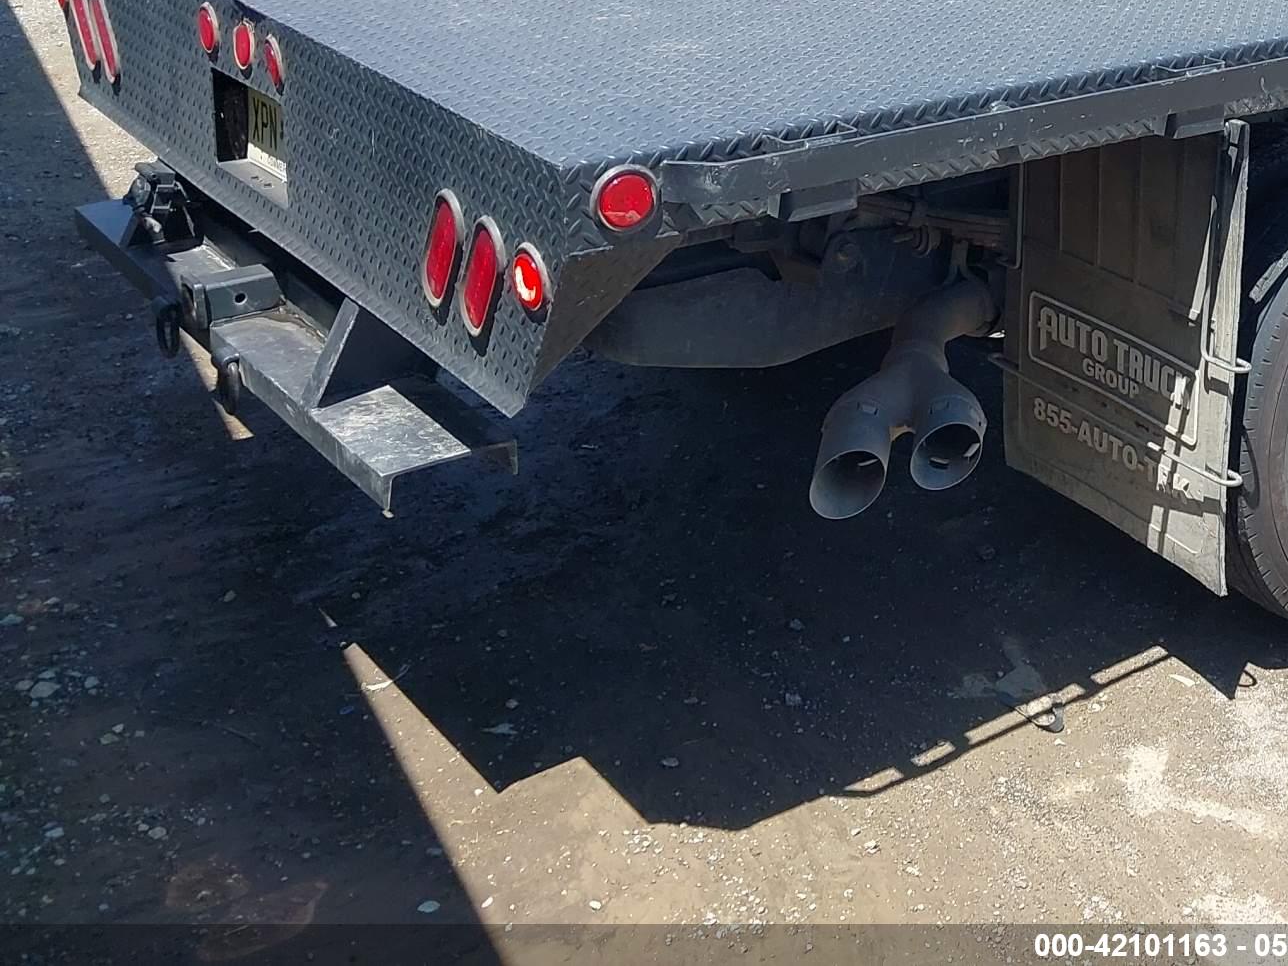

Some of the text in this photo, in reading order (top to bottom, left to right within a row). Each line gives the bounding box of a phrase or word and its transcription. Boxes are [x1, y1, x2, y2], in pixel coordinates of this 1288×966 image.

[1037, 306, 1191, 410] AUTO TRUCK
[1082, 357, 1140, 399] GROUP
